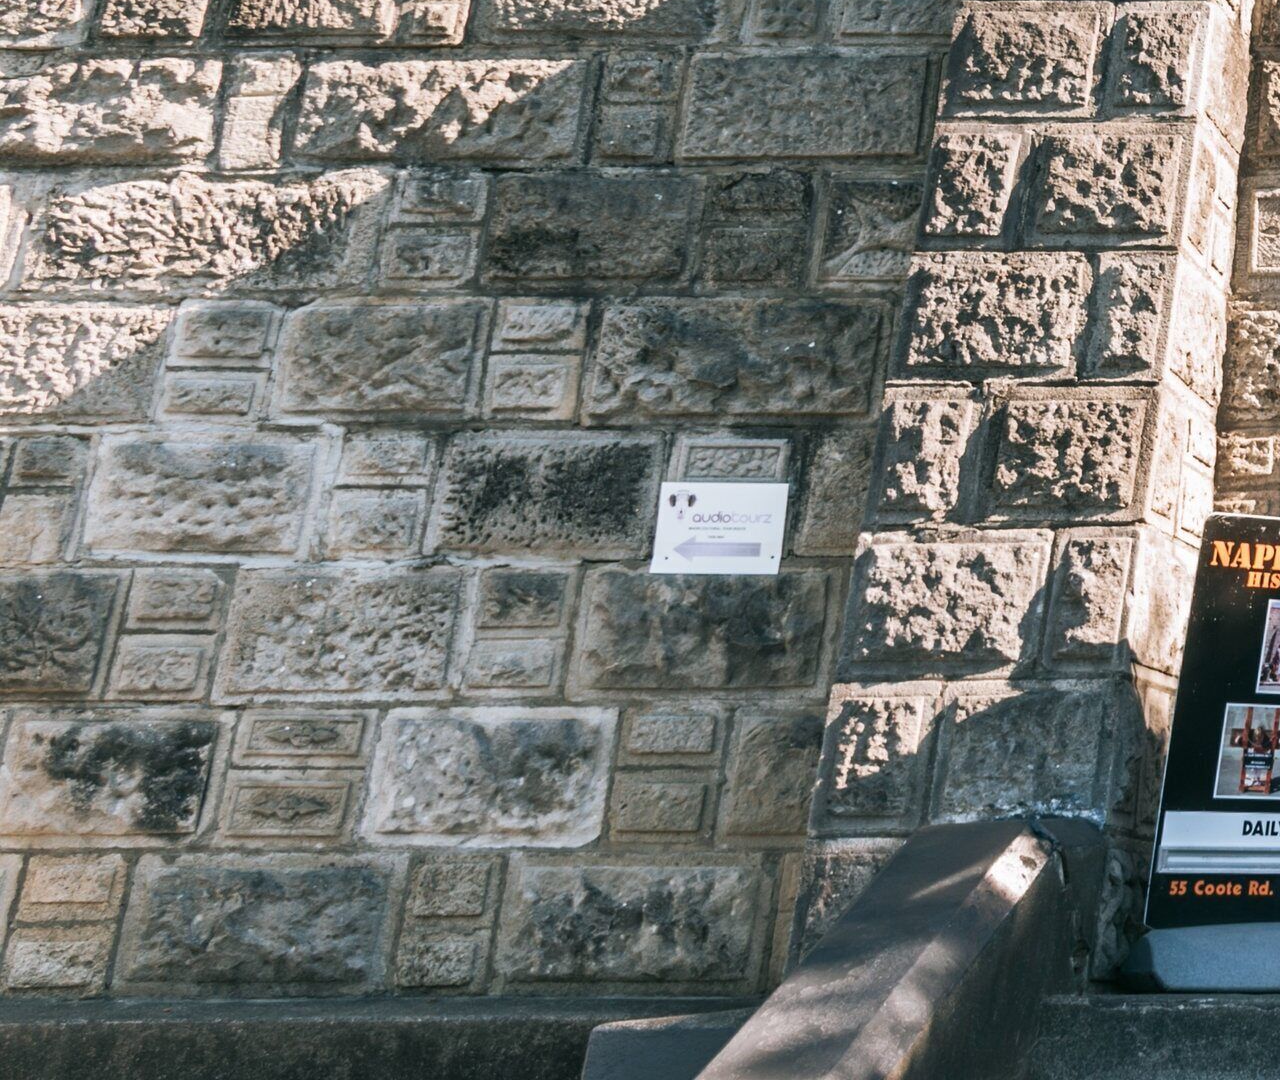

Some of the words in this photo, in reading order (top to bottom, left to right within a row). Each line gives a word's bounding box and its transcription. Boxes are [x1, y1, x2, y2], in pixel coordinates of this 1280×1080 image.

[1169, 880, 1187, 896] 55
[1194, 880, 1242, 896] Coote
[1248, 880, 1274, 896] Rd.
